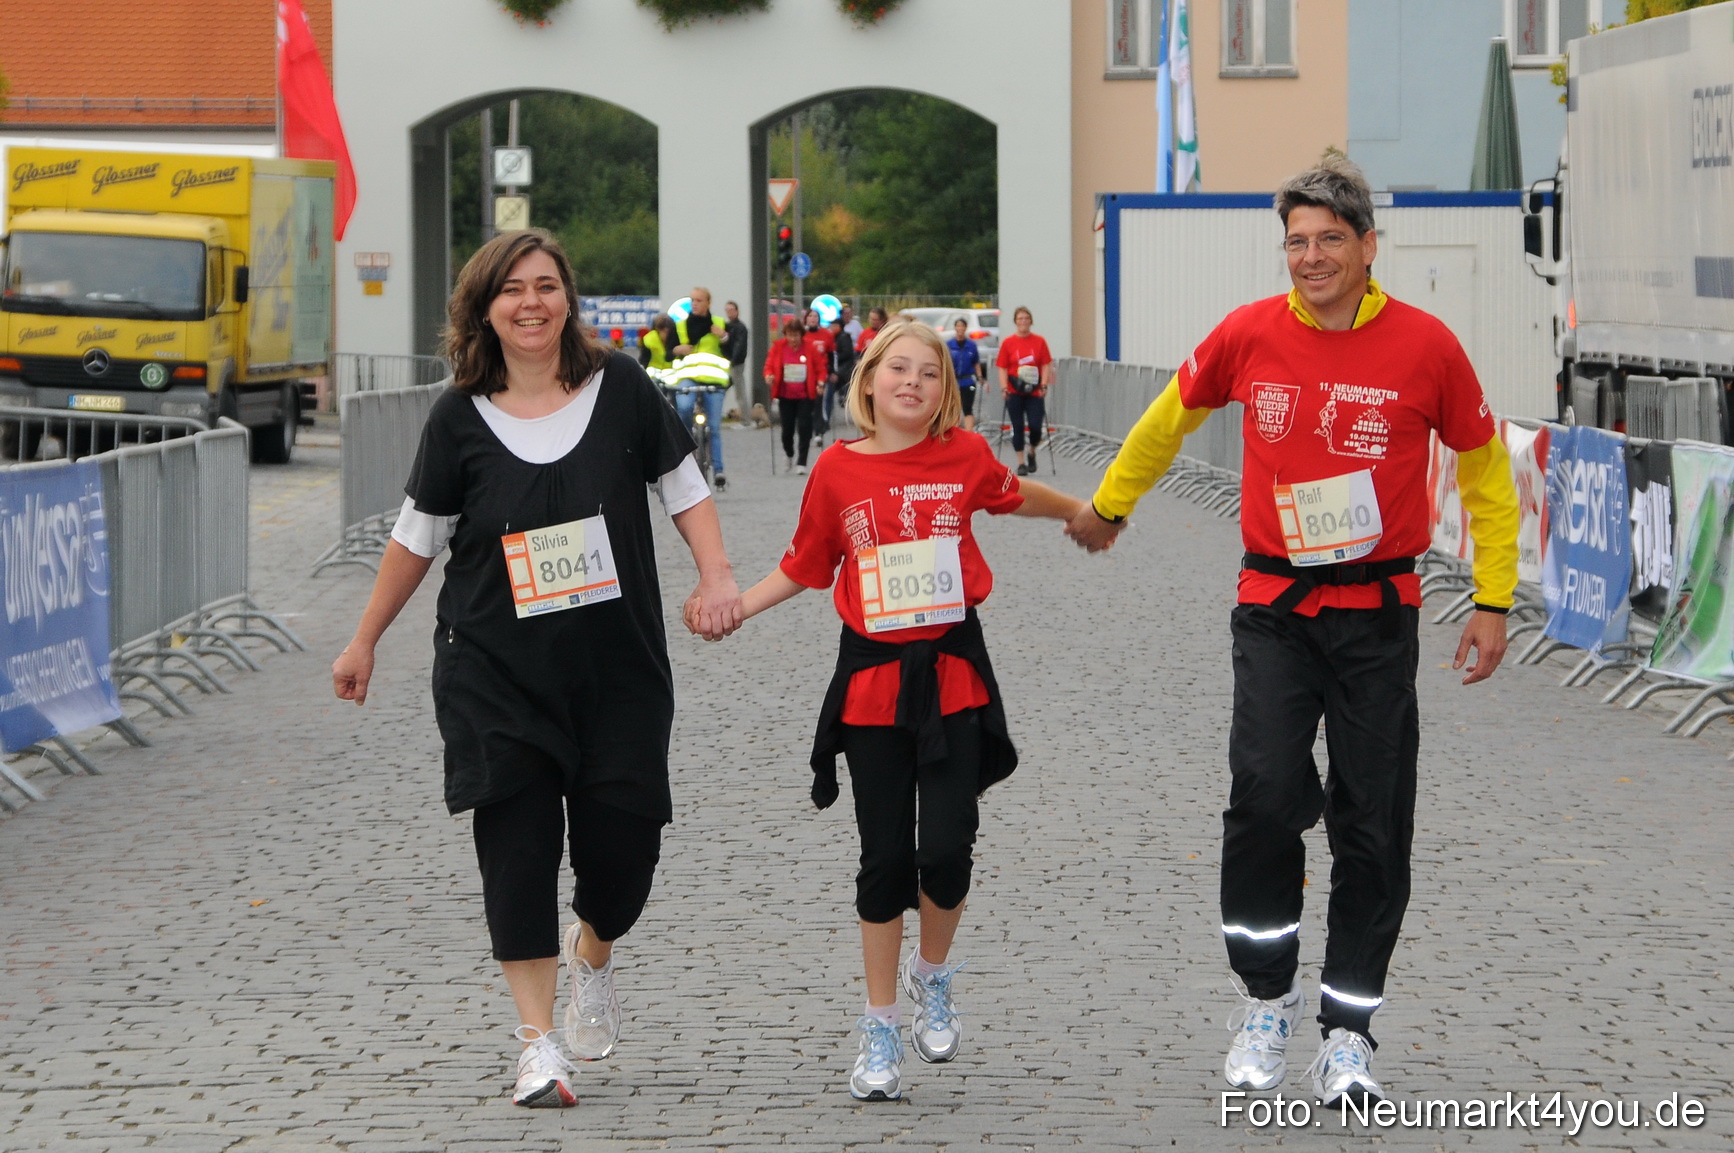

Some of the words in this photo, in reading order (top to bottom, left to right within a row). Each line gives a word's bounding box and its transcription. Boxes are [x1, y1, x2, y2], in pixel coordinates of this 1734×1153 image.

[13, 159, 81, 192] Glossner
[92, 162, 160, 195] Glossner
[171, 166, 239, 198] Glossner
[18, 325, 58, 345] Glossner
[76, 328, 118, 348] Glossner
[136, 331, 176, 350] Glossner
[1257, 390, 1290, 402] IMMER
[1319, 382, 1332, 391] 11.
[1333, 383, 1399, 400] NEUMARKTER
[1330, 391, 1385, 406] STADTLAUF
[1255, 400, 1290, 411] WIEDER
[1257, 409, 1286, 425] NEU
[1259, 422, 1285, 434] MARKT
[1349, 433, 1389, 443] 19.09.2010
[889, 486, 903, 496] 11.
[903, 483, 964, 494] NEUMARKTER
[902, 491, 954, 502] STADTLAUF
[1297, 487, 1322, 505] Ralf
[1305, 504, 1371, 537] 8040
[531, 533, 569, 552] Silvia
[540, 549, 604, 583] 8041
[882, 552, 913, 567] Lena
[580, 584, 619, 600] PFLEIDERER
[888, 570, 953, 600] 8039
[926, 608, 963, 619] PFLEIDERER
